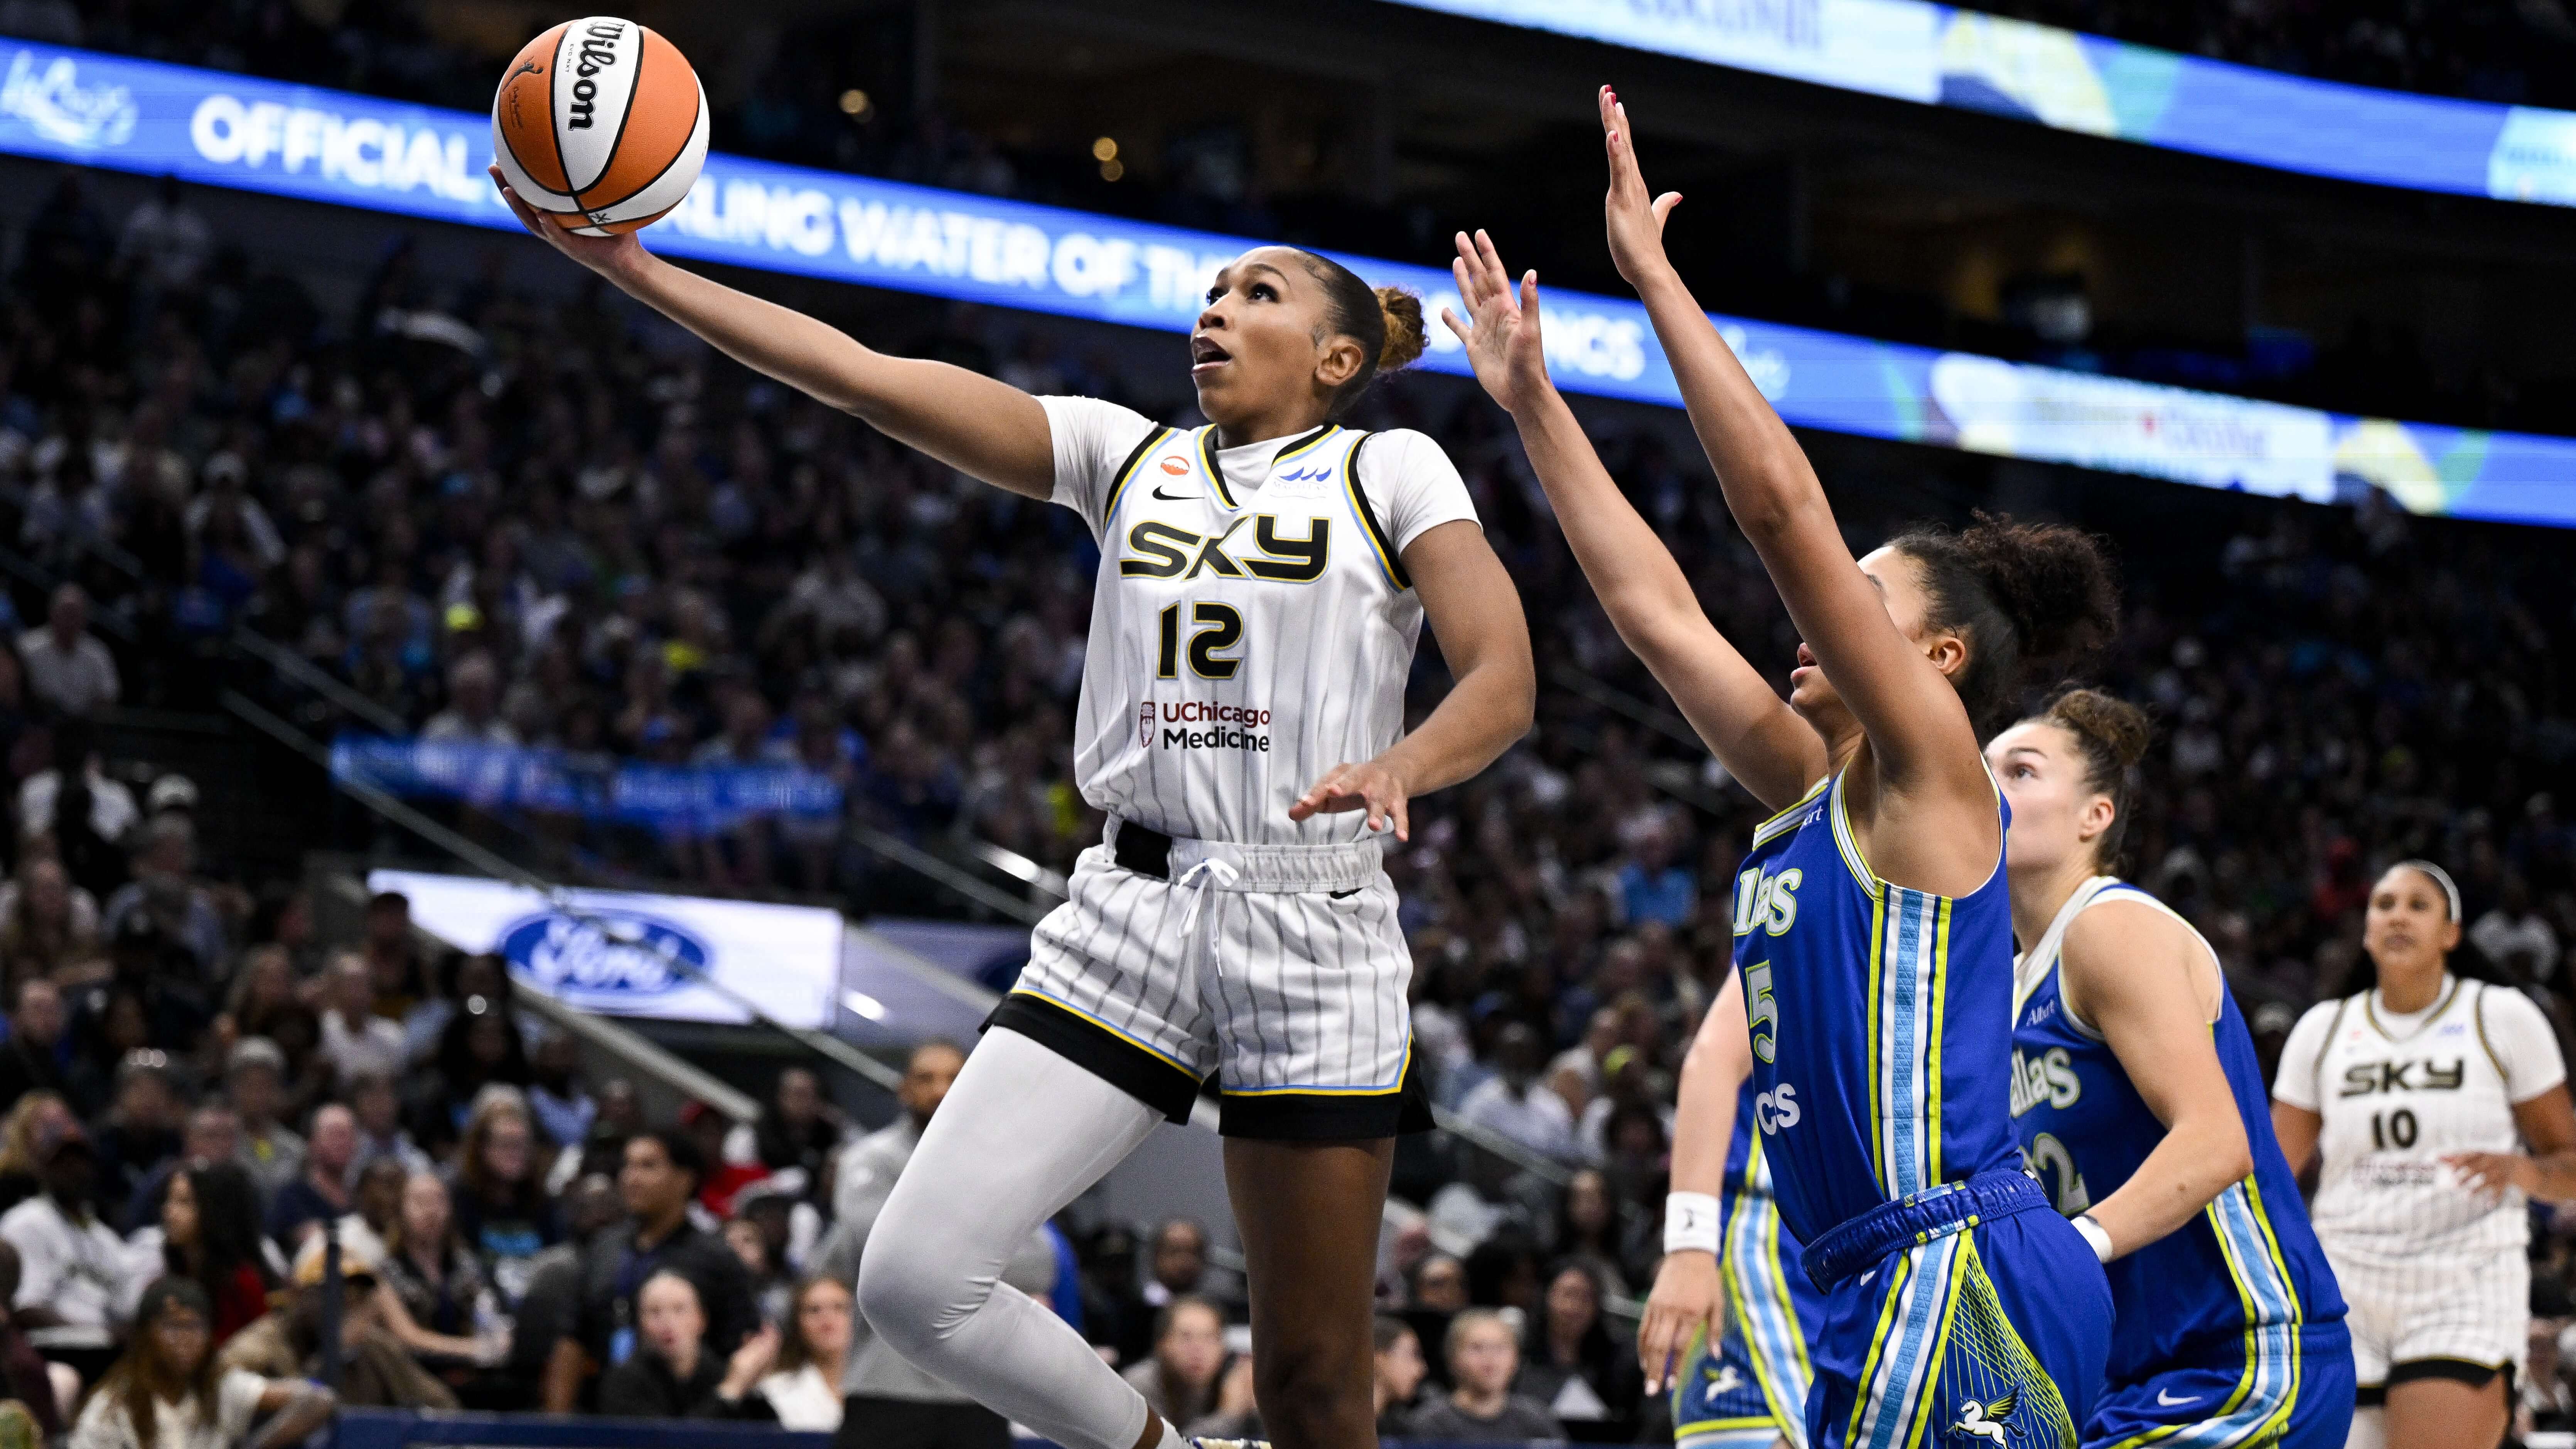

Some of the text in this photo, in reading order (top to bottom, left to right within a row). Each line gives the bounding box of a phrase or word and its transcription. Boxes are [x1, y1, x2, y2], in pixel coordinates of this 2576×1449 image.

[568, 21, 626, 131] Wilson
[190, 94, 487, 202] OFFICIAL
[666, 174, 833, 256] LING
[839, 196, 1054, 291] WATER
[1052, 232, 1140, 298] OF
[1142, 245, 1221, 313] TH
[1539, 305, 1645, 381] NGS
[1119, 512, 1332, 584] SKY
[1156, 600, 1244, 680] 12
[1163, 701, 1271, 728] UChicago
[1163, 726, 1269, 752] Medicine
[2340, 1057, 2464, 1098] SKY
[2372, 1108, 2418, 1150] 10
[2025, 1132, 2090, 1217] 2
